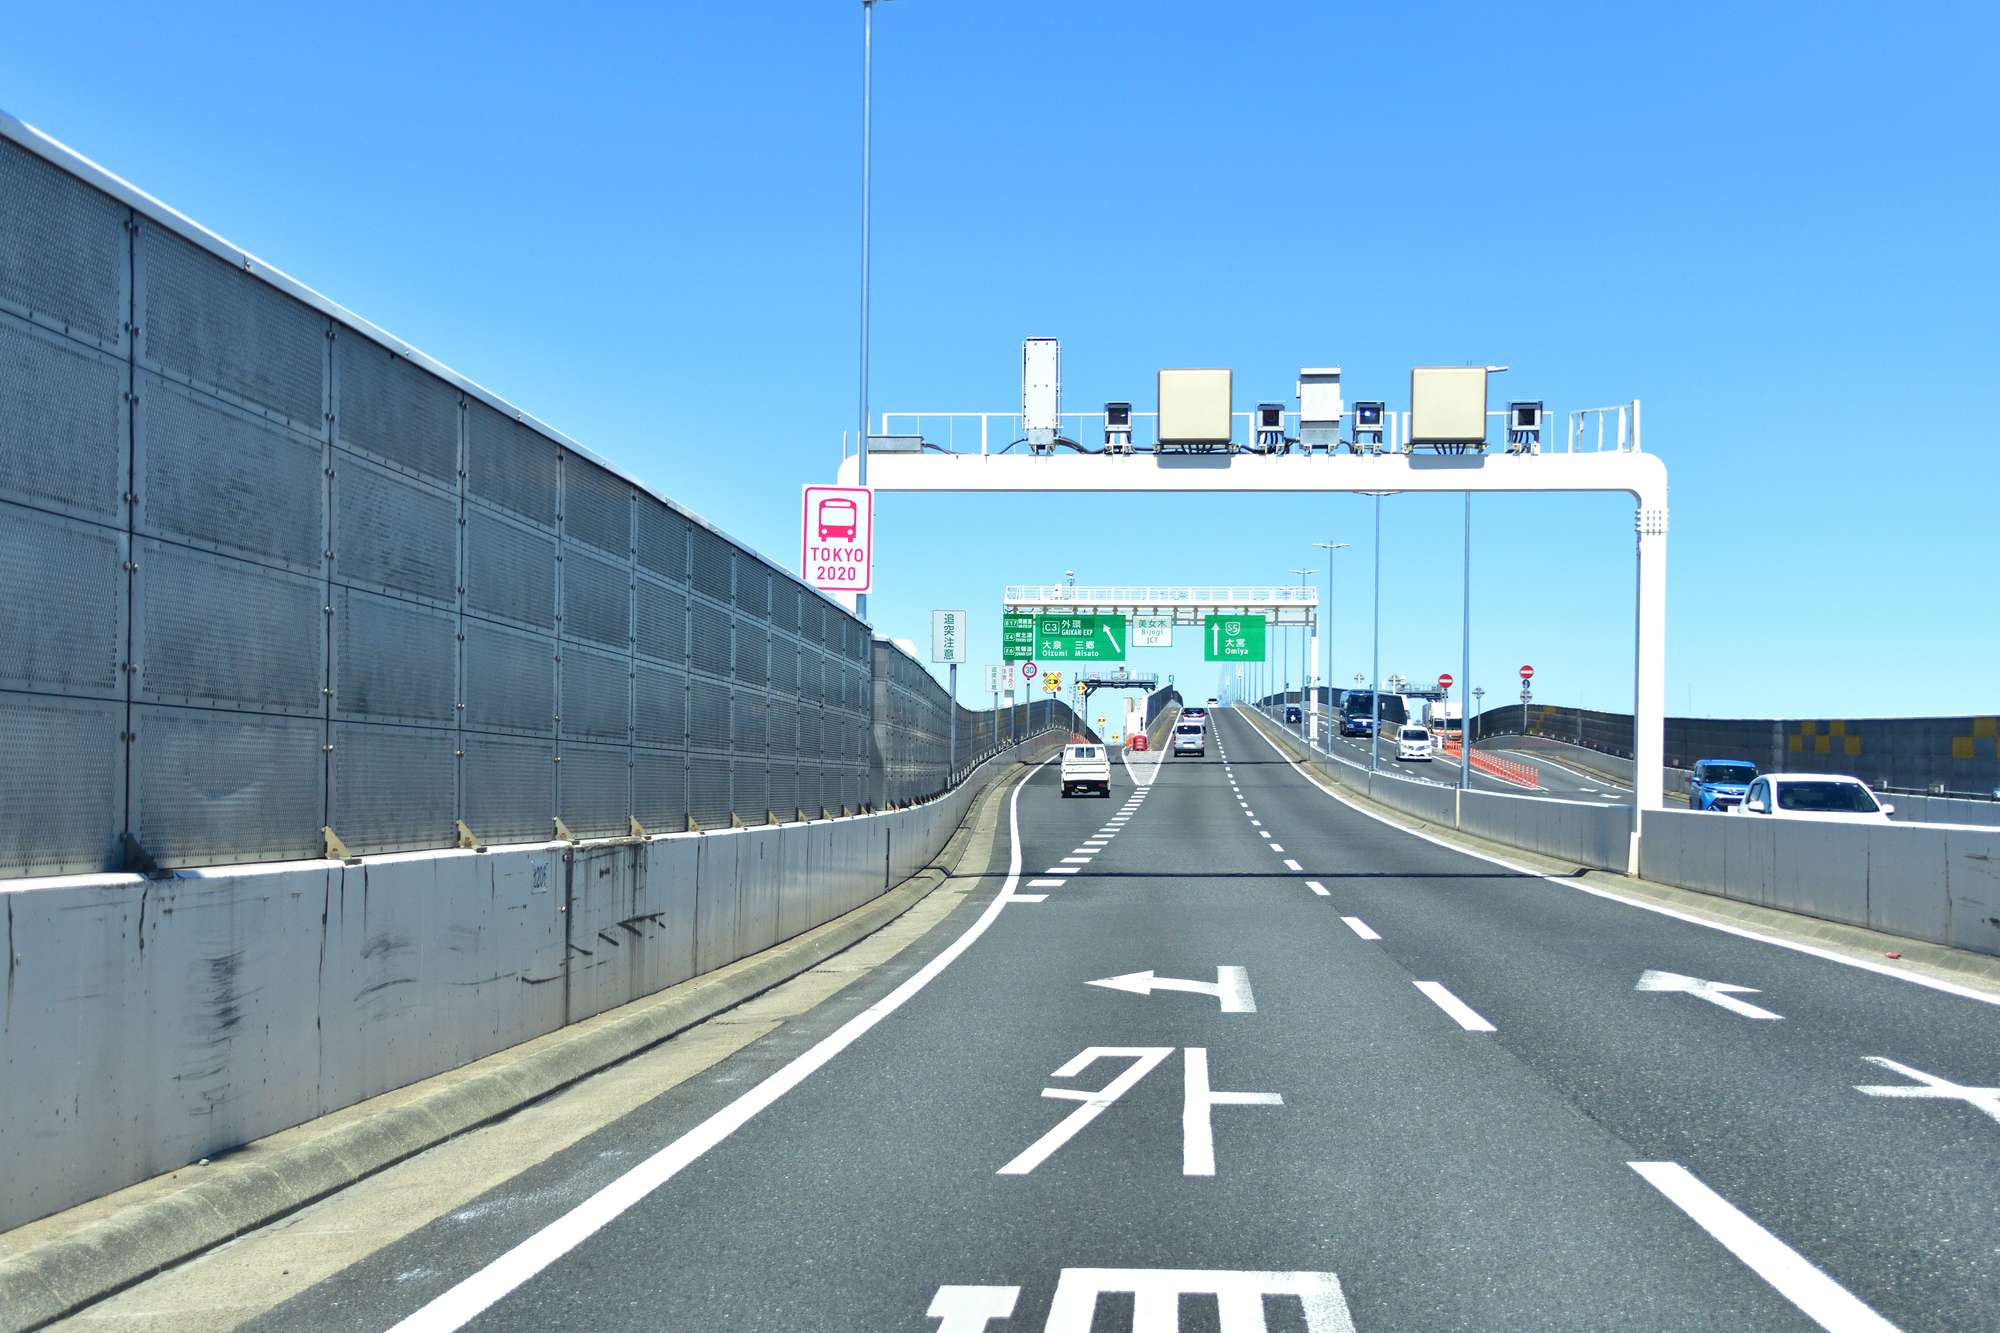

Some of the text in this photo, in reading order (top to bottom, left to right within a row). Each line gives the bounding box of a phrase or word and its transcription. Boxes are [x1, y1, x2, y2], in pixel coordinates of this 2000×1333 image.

[810, 547, 863, 562] TOKYO
[817, 566, 856, 580] 2020
[1044, 623, 1057, 632] C3
[1061, 619, 1081, 629] 外環
[1138, 619, 1167, 629] 美女木
[1227, 623, 1240, 633] S5
[943, 613, 955, 660] 追突注意
[1146, 636, 1159, 644] JCT
[1225, 638, 1246, 648] 大宮
[1042, 649, 1068, 657] Oizumi
[1074, 649, 1099, 657] Misato
[1225, 647, 1249, 656] Omiya
[1025, 666, 1035, 674] 30
